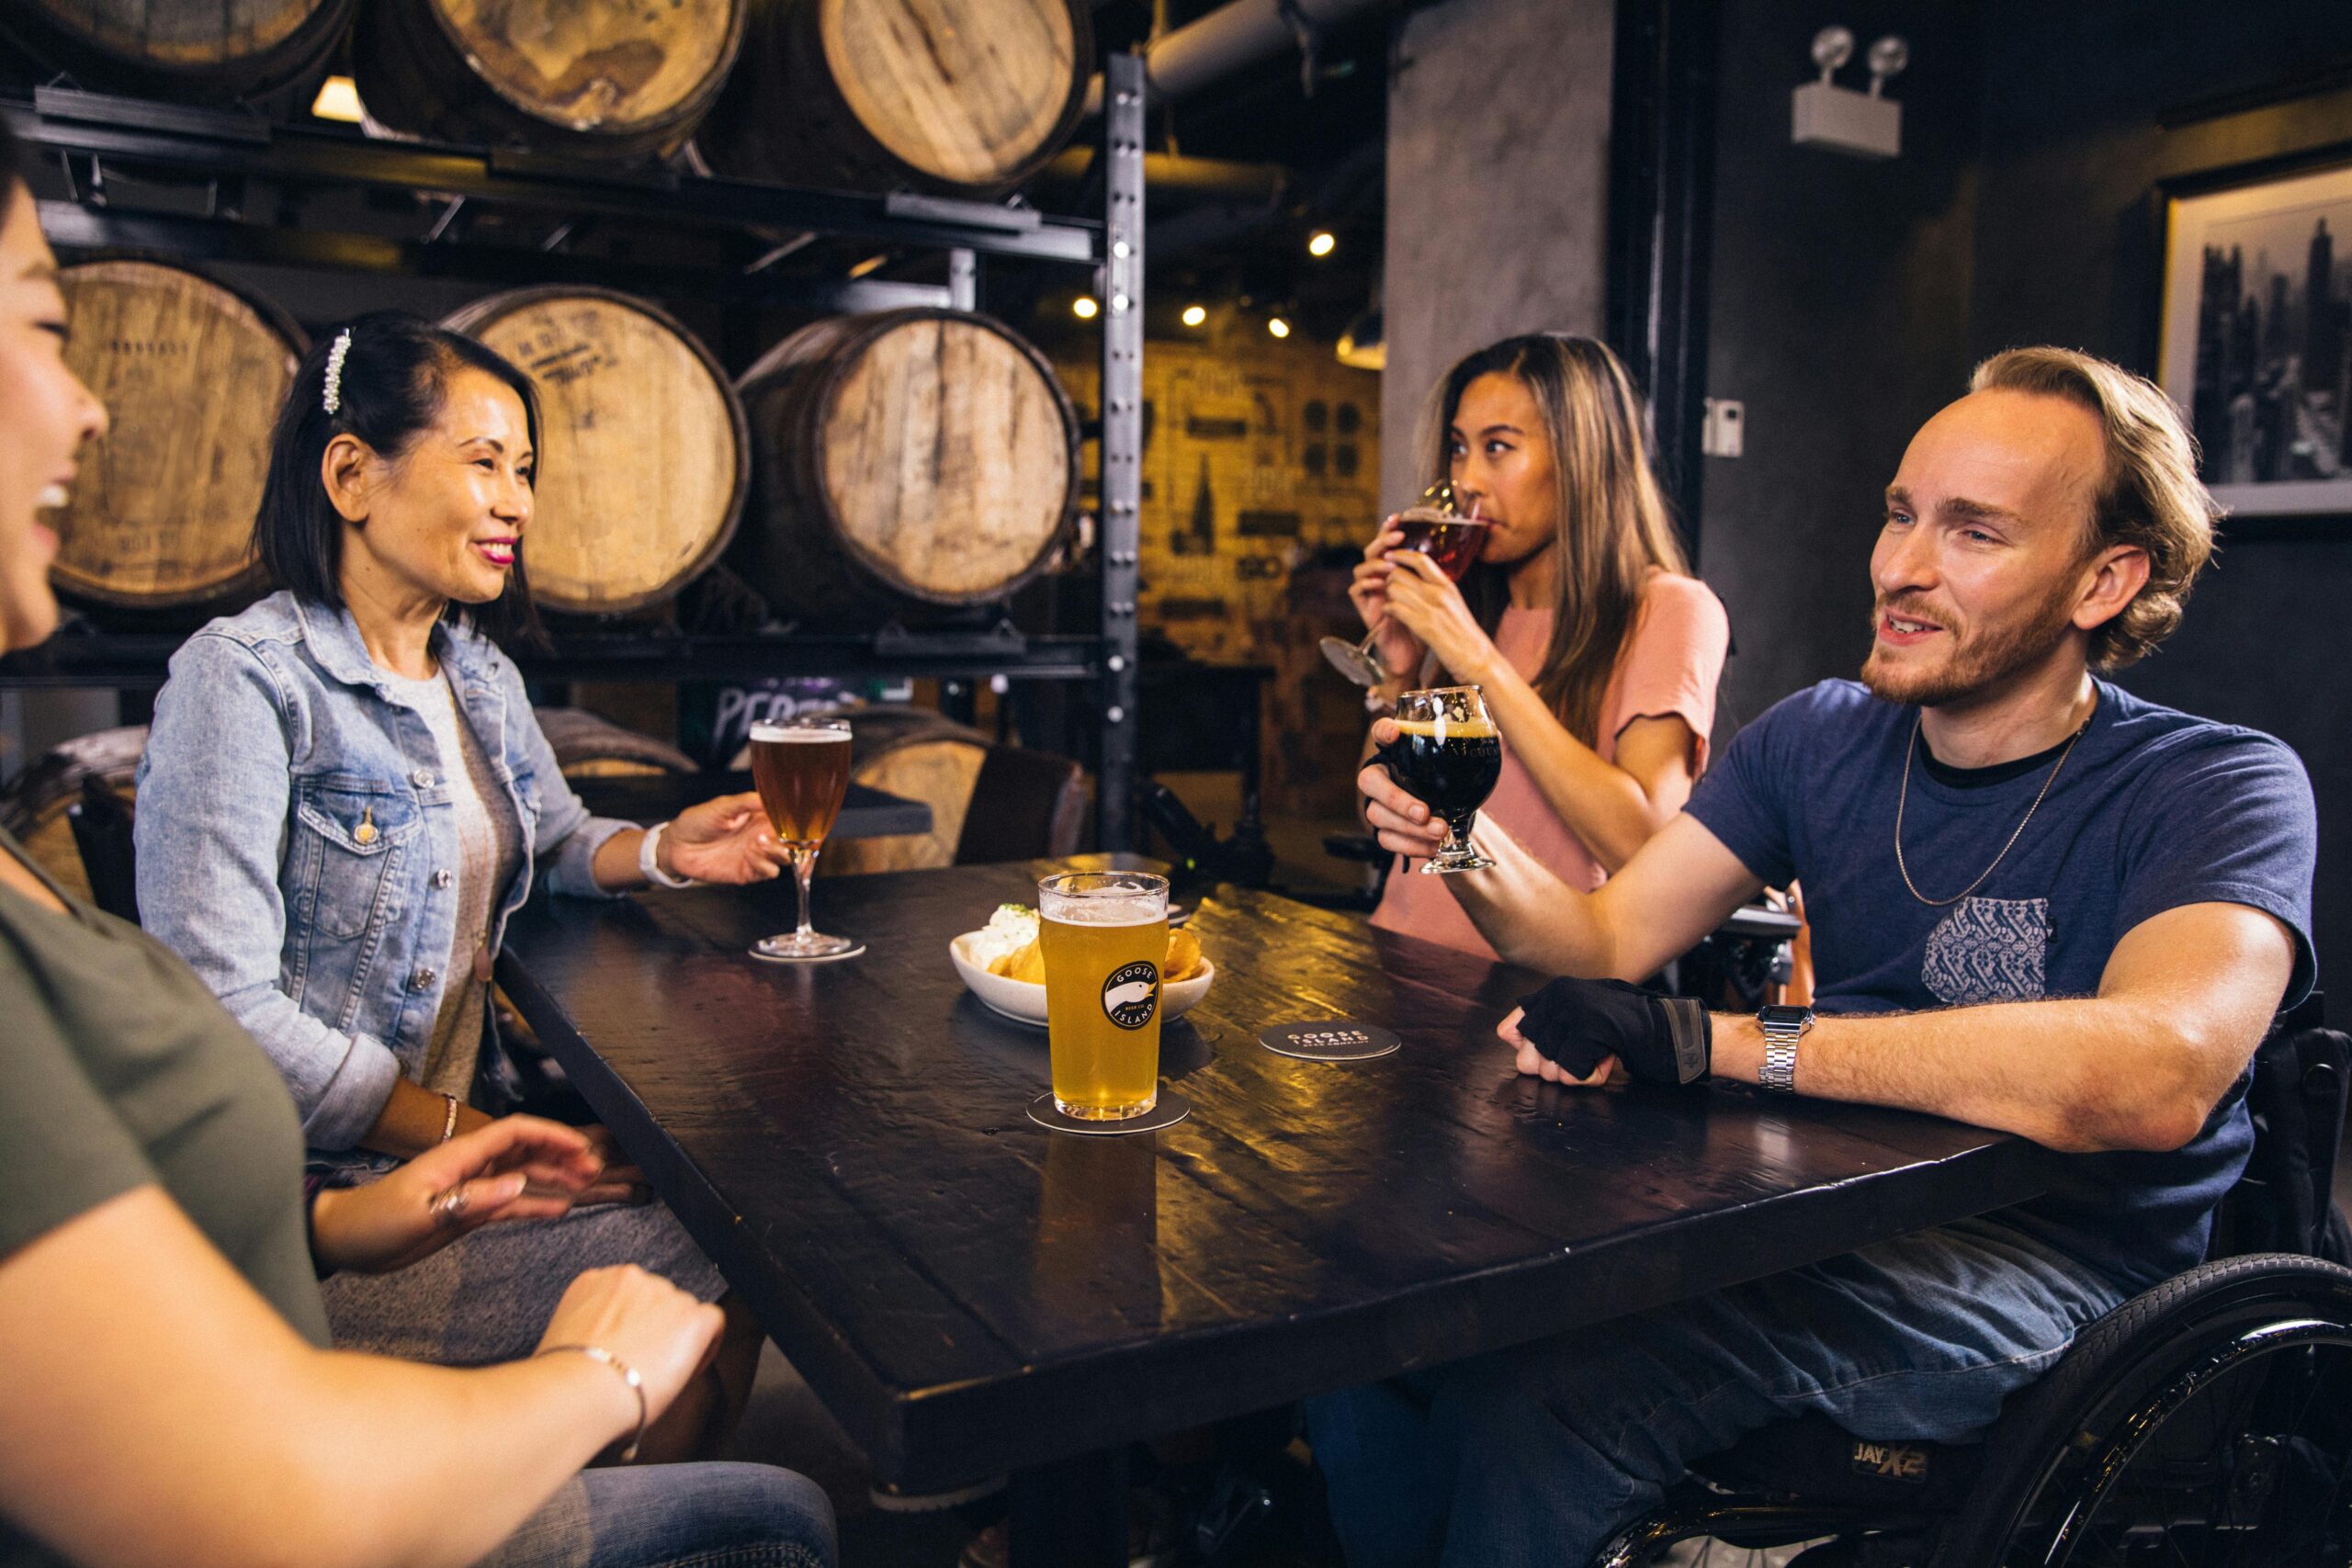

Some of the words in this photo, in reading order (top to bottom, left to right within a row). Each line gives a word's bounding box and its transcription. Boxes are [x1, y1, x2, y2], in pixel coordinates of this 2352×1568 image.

[1116, 967, 1153, 983] GOOSE
[1114, 1003, 1153, 1024] ISLAND
[1287, 1030, 1363, 1040] GOOSE
[1293, 1035, 1369, 1044] ISLAND
[1854, 1442, 1886, 1464] JAY
